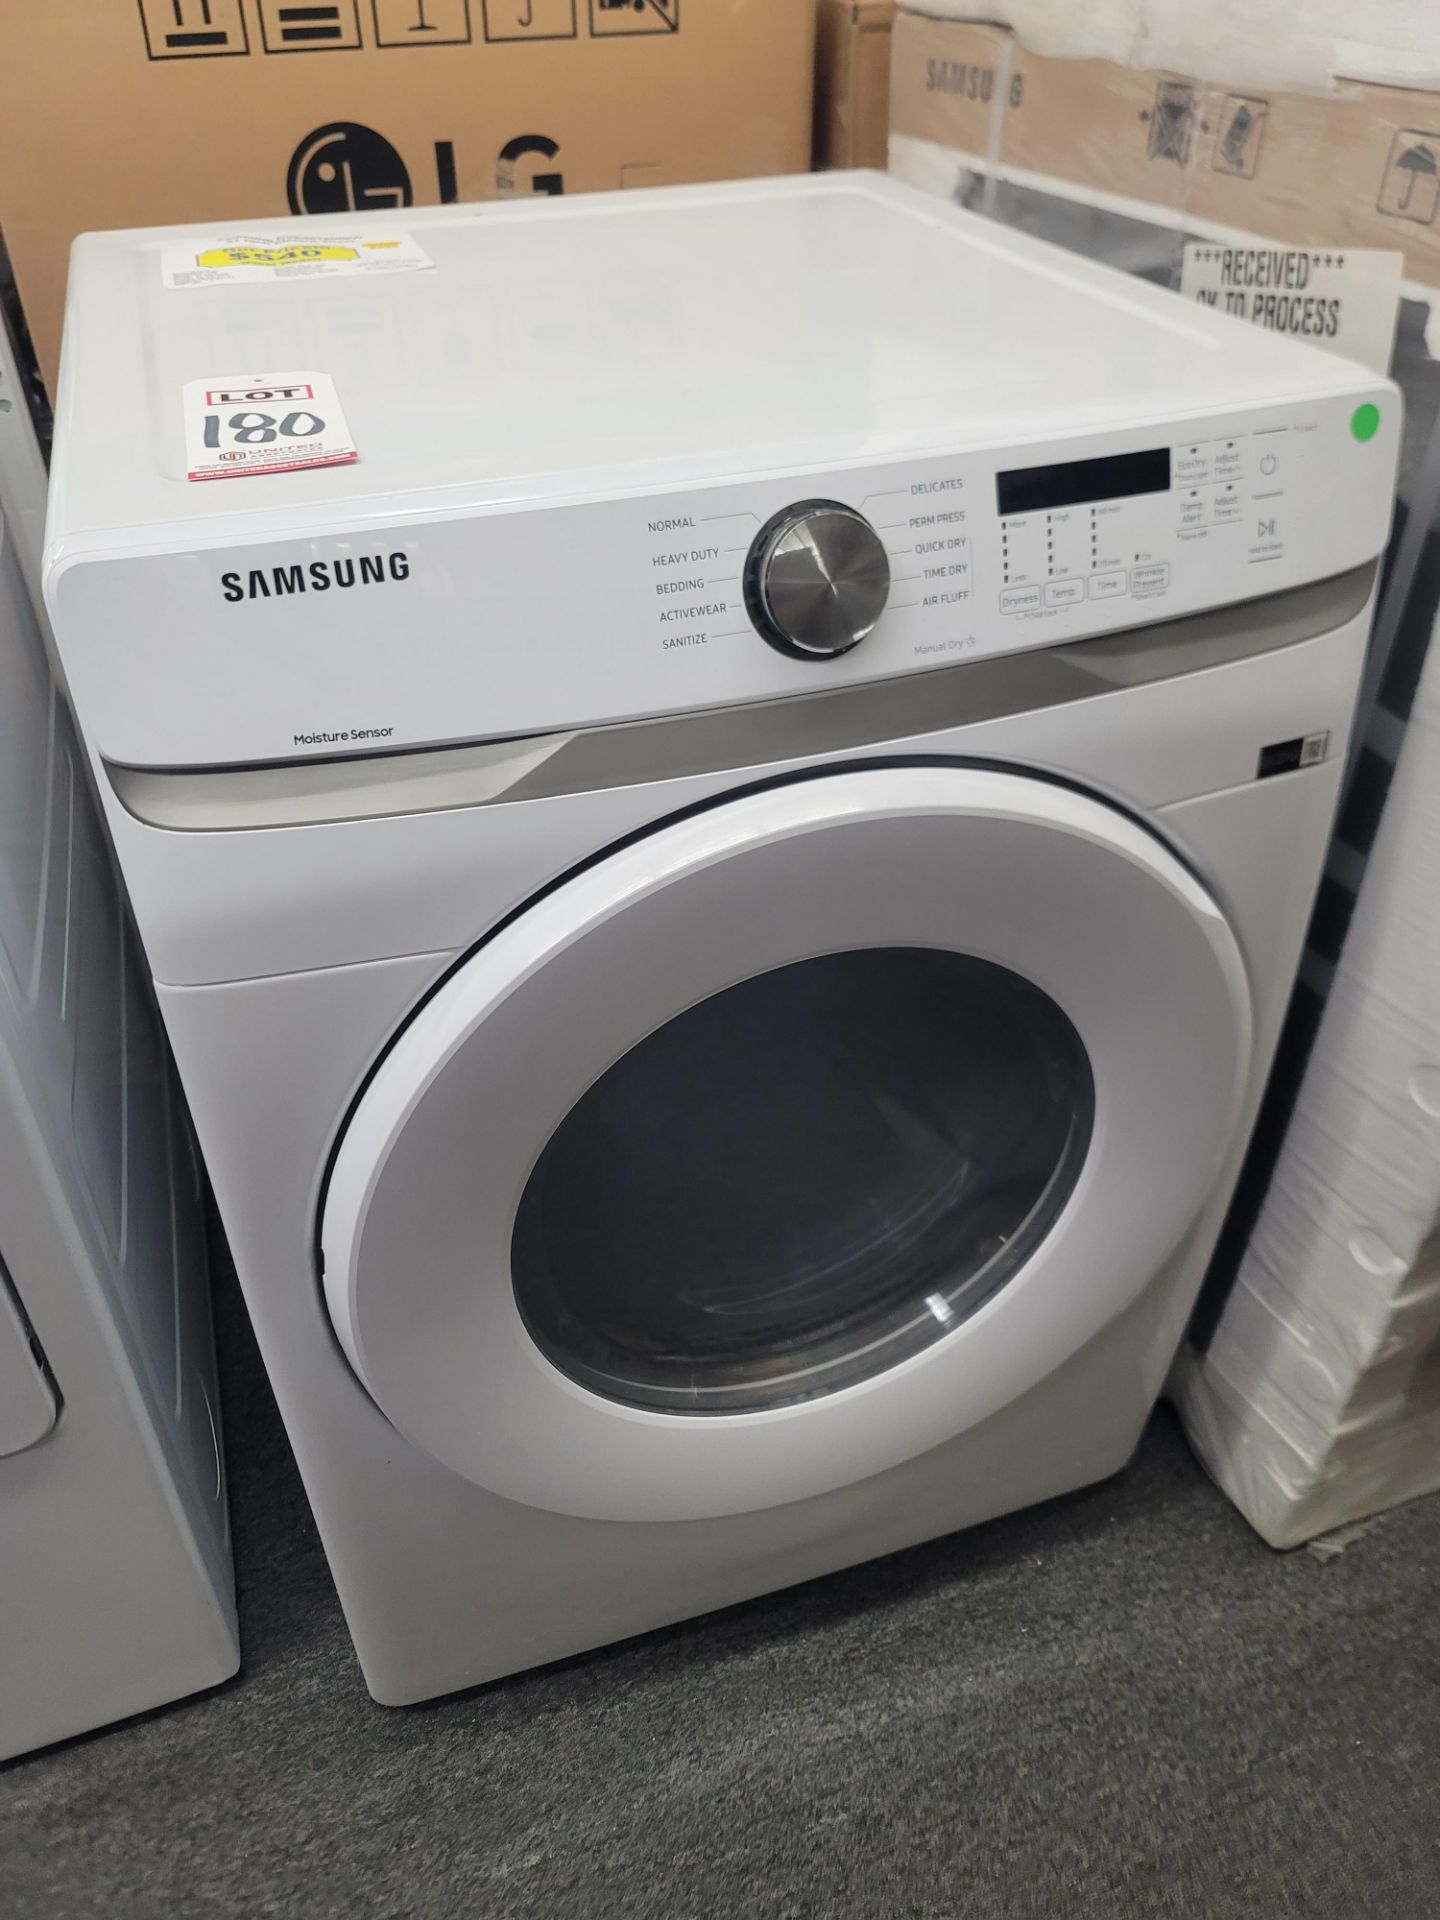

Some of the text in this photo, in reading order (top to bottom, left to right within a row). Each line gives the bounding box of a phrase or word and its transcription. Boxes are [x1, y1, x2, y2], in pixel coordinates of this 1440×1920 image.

[927, 58, 1024, 108] SAMSUG
[1252, 293, 1341, 338] PROCESS
[220, 388, 300, 402] LOT
[203, 411, 326, 449] 180
[911, 478, 964, 496] DELICATES
[648, 517, 697, 533] NORMAL
[909, 511, 966, 529] PERM PRESS
[915, 538, 967, 555] QUICK DRY
[652, 548, 720, 567] HEAVY DUTY
[221, 552, 410, 602] SAMSUNG
[923, 563, 968, 580] TIME DRY
[656, 579, 705, 595] BEDDING
[922, 590, 970, 608] AIR FLUFF
[1002, 594, 1039, 609] Dryness
[660, 603, 727, 622] ACTIVEWEAR
[662, 633, 708, 650] SANITIZE
[914, 639, 964, 656] Manual Dry
[293, 726, 394, 746] Moisture Sensor
